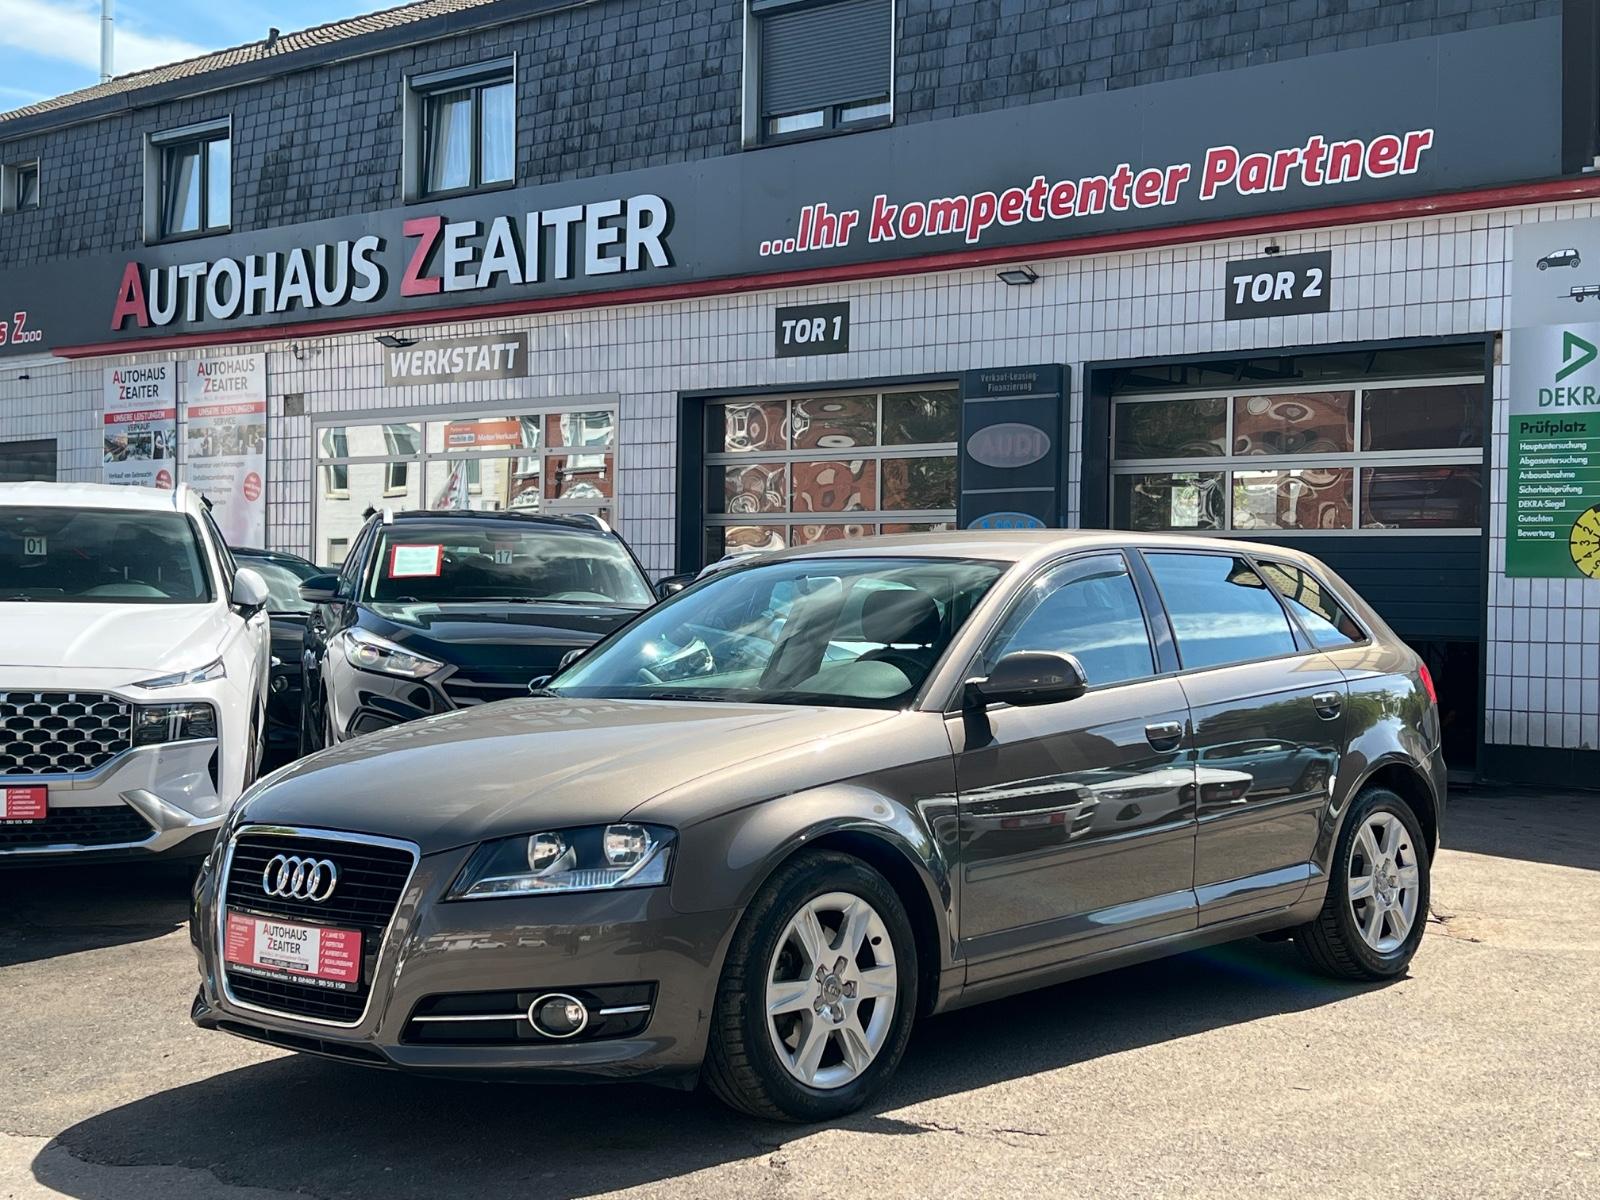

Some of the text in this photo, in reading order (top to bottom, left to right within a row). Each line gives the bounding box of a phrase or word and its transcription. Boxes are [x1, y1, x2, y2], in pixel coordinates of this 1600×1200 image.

[759, 129, 1434, 256] ...Ihr kompetenter Partner
[111, 194, 671, 331] AUTOHAUS ZEAITER
[1232, 268, 1323, 305] TOR 2
[781, 316, 843, 345] TOR 1
[196, 358, 256, 377] AUTOHAUS
[390, 341, 520, 378] WERKSTATT
[112, 366, 166, 385] AUTOHAUS
[119, 384, 159, 401] ZEAITER
[204, 377, 249, 394] ZEAITER
[1520, 420, 1587, 437] Prüfplatz
[1519, 440, 1587, 452] Hauptuntersuchung
[1519, 455, 1588, 467] Abgasuntersuchung
[1518, 470, 1576, 480] Anbauabnahme
[1518, 484, 1583, 496] Sicherheitsprüfung
[1518, 499, 1566, 509] DEKRA-Siegel
[1517, 514, 1554, 523] Gutachten
[1517, 528, 1555, 539] Bewertung
[27, 538, 43, 554] 01
[498, 550, 511, 564] 17
[263, 923, 308, 942] AUTOHAUS
[267, 937, 301, 955] ZEAITER
